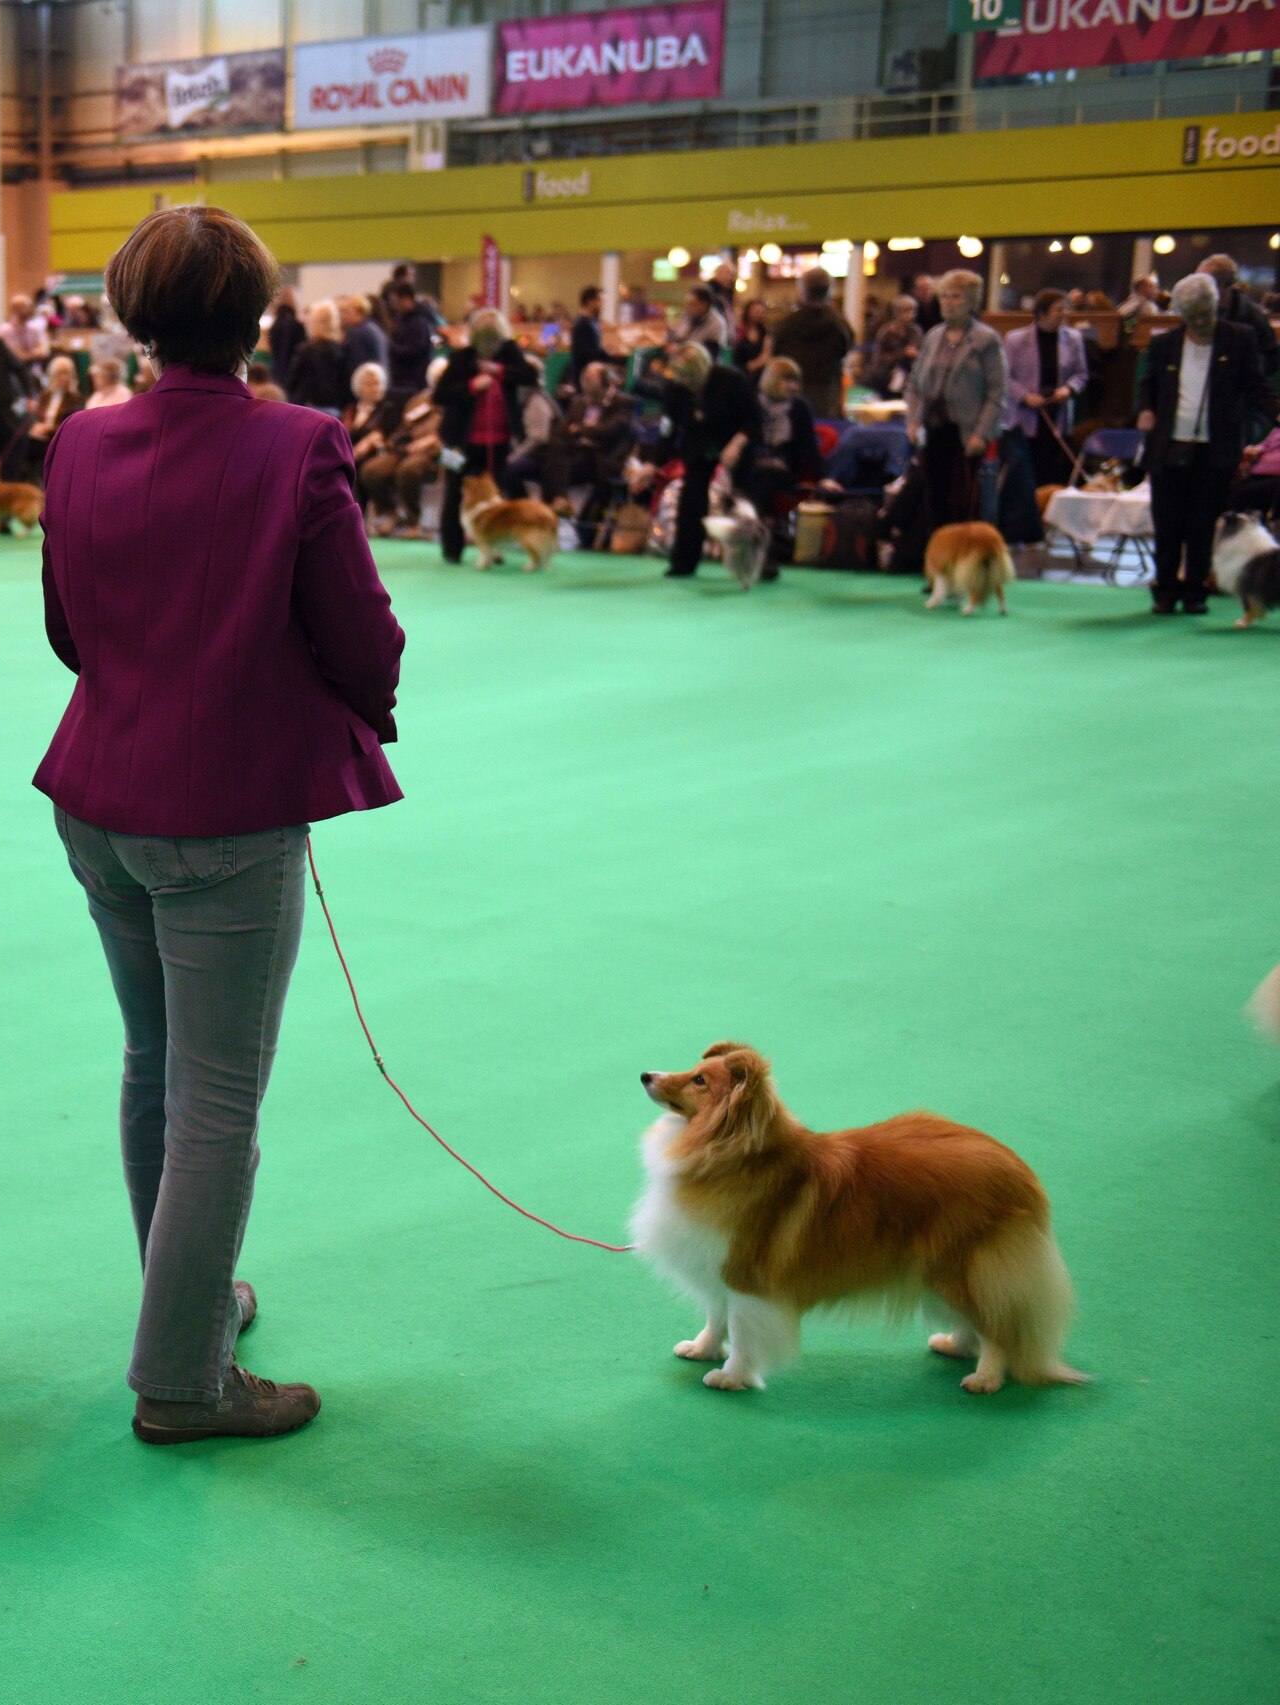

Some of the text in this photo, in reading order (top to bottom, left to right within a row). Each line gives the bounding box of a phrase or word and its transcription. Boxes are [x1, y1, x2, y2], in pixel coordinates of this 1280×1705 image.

[971, 0, 1003, 20] 10
[996, 0, 1276, 37] UKAN
[506, 33, 708, 82] EUKANUBA
[310, 73, 469, 112] ROYAL CANIN
[1203, 123, 1280, 160] food
[536, 168, 591, 197] food
